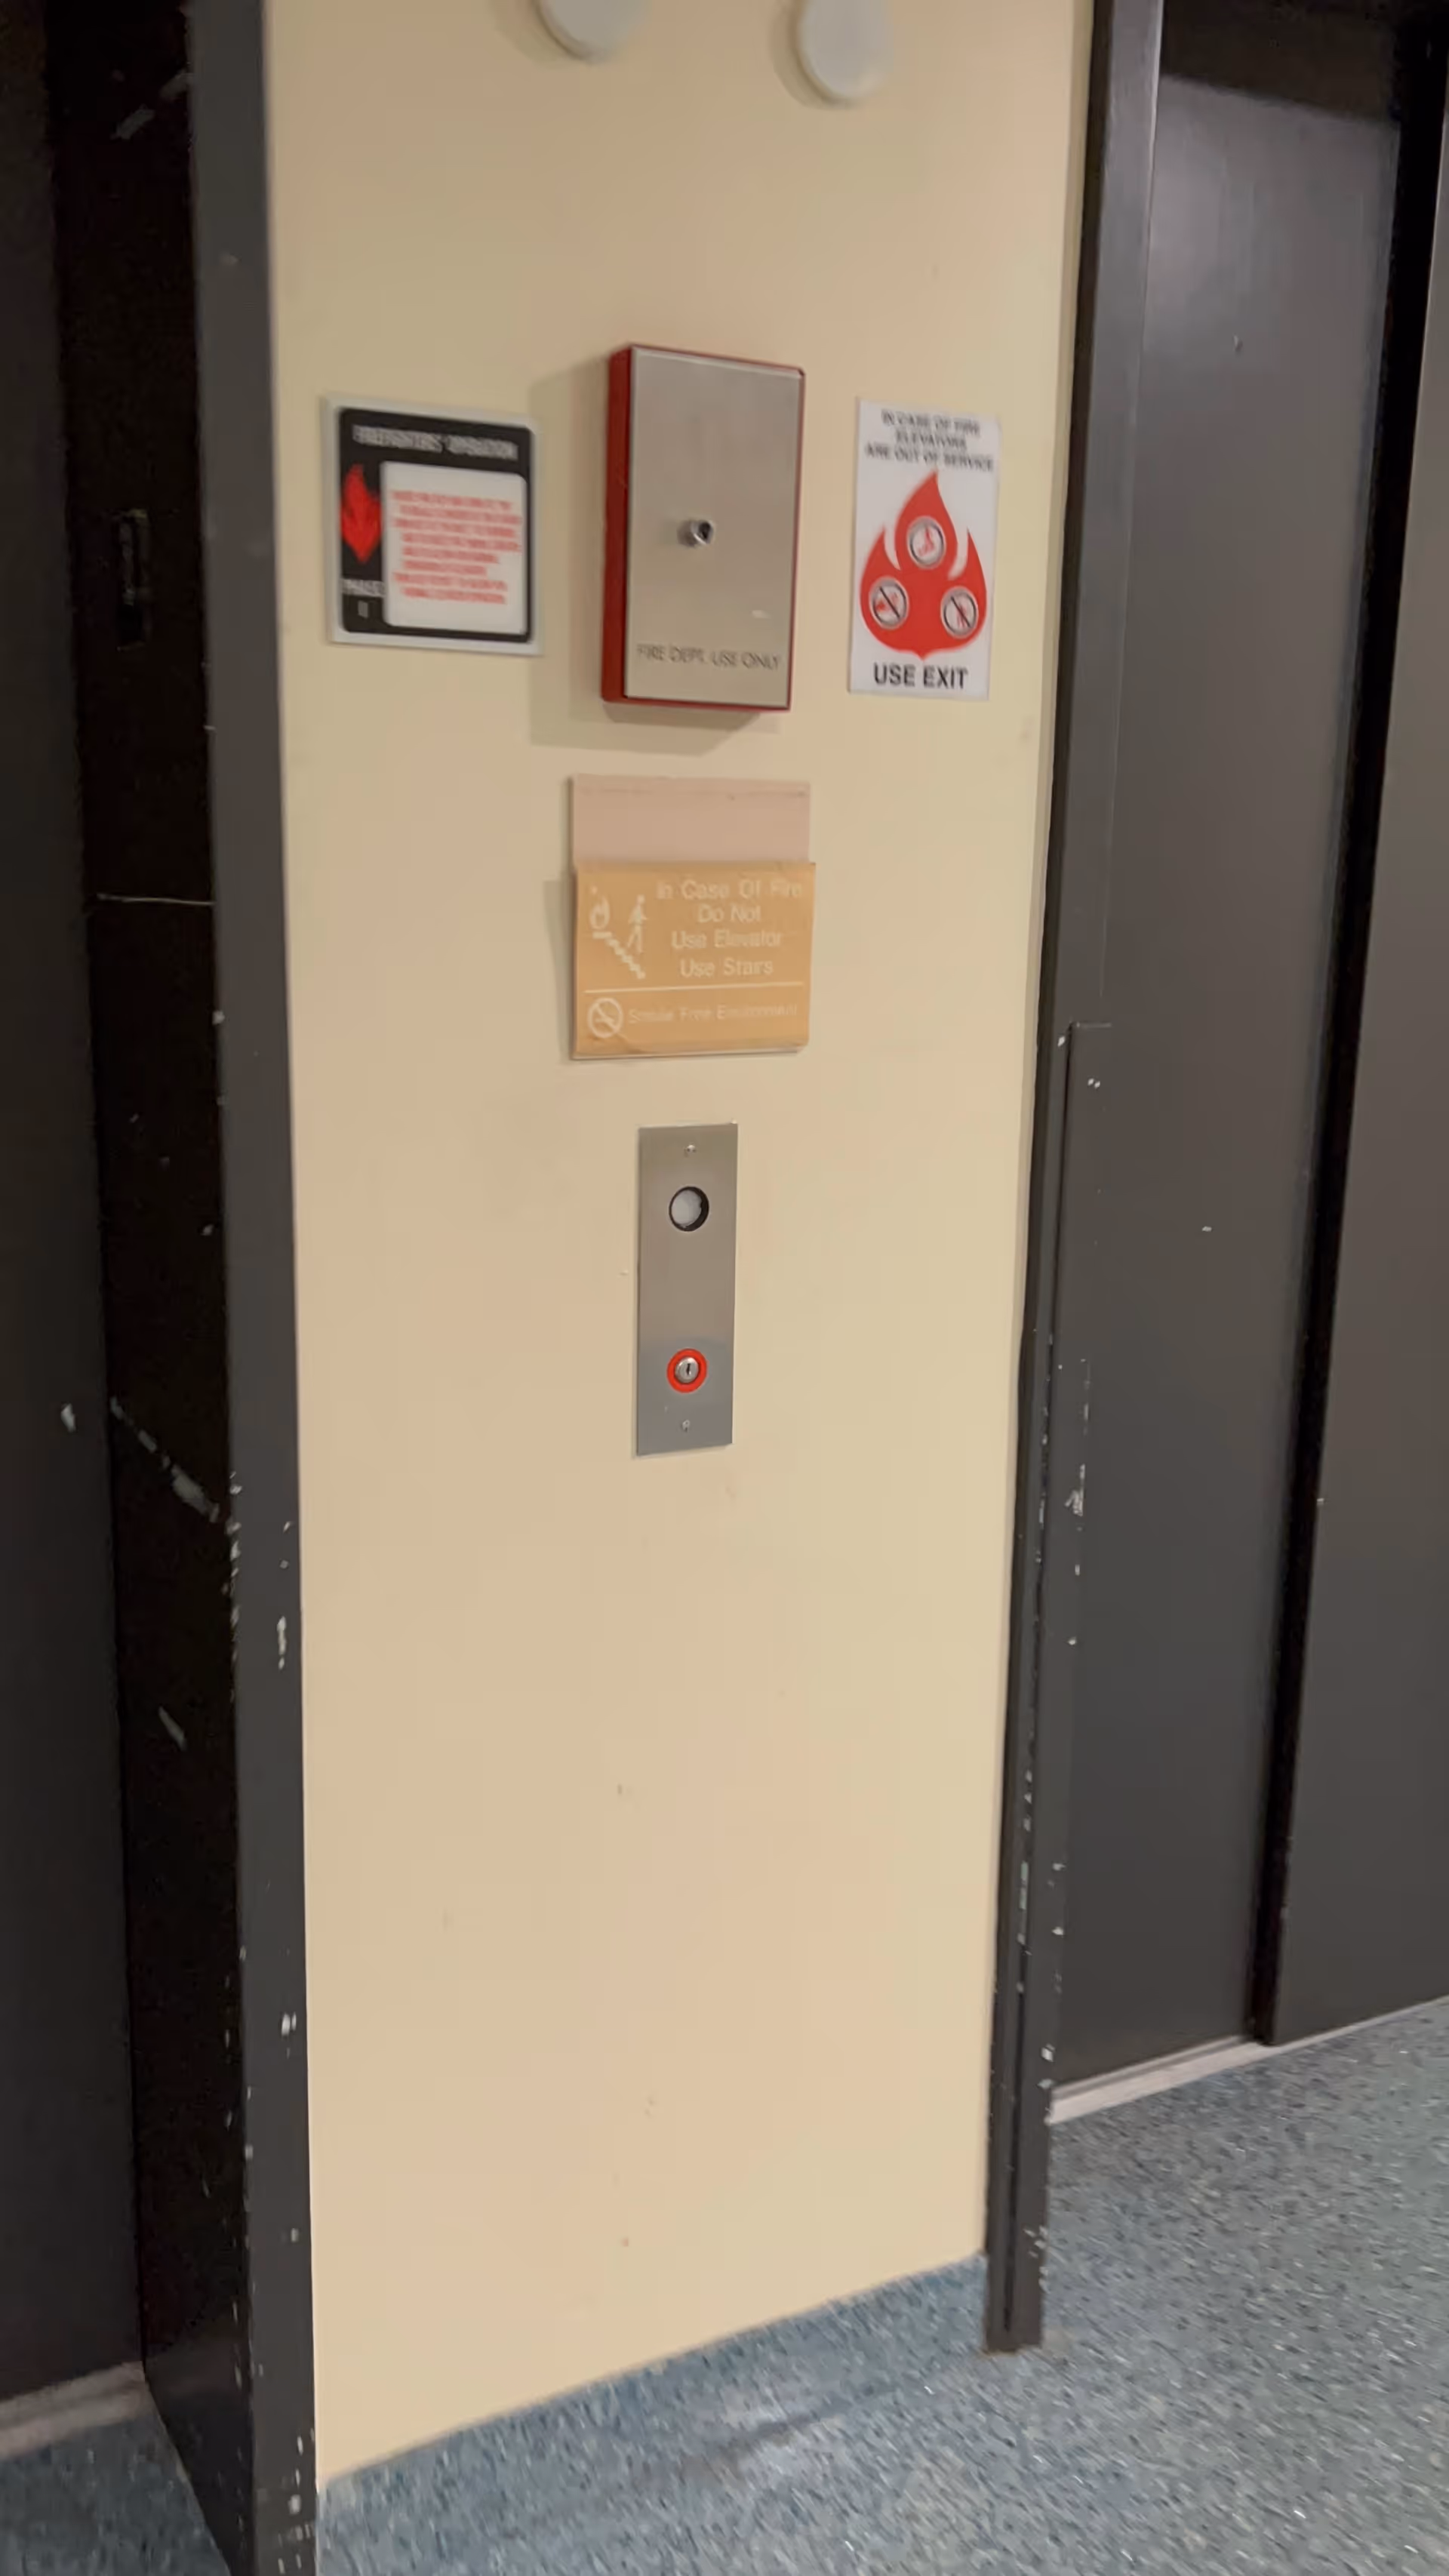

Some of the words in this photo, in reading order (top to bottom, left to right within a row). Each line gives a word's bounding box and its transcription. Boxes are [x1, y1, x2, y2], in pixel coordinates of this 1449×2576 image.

[637, 644, 665, 661] FIRE
[711, 649, 737, 667] USE
[741, 651, 779, 669] ONLY
[874, 662, 915, 687] USE
[923, 665, 968, 688] EXIT
[656, 881, 673, 899] In
[681, 879, 730, 899] Case
[738, 879, 761, 898] Of
[771, 879, 803, 897] Fire
[697, 904, 724, 923] Do
[731, 903, 761, 922] Not
[672, 931, 706, 949] Use
[714, 929, 781, 948] Elevator
[680, 959, 715, 977] Use
[723, 958, 774, 975] Stairs
